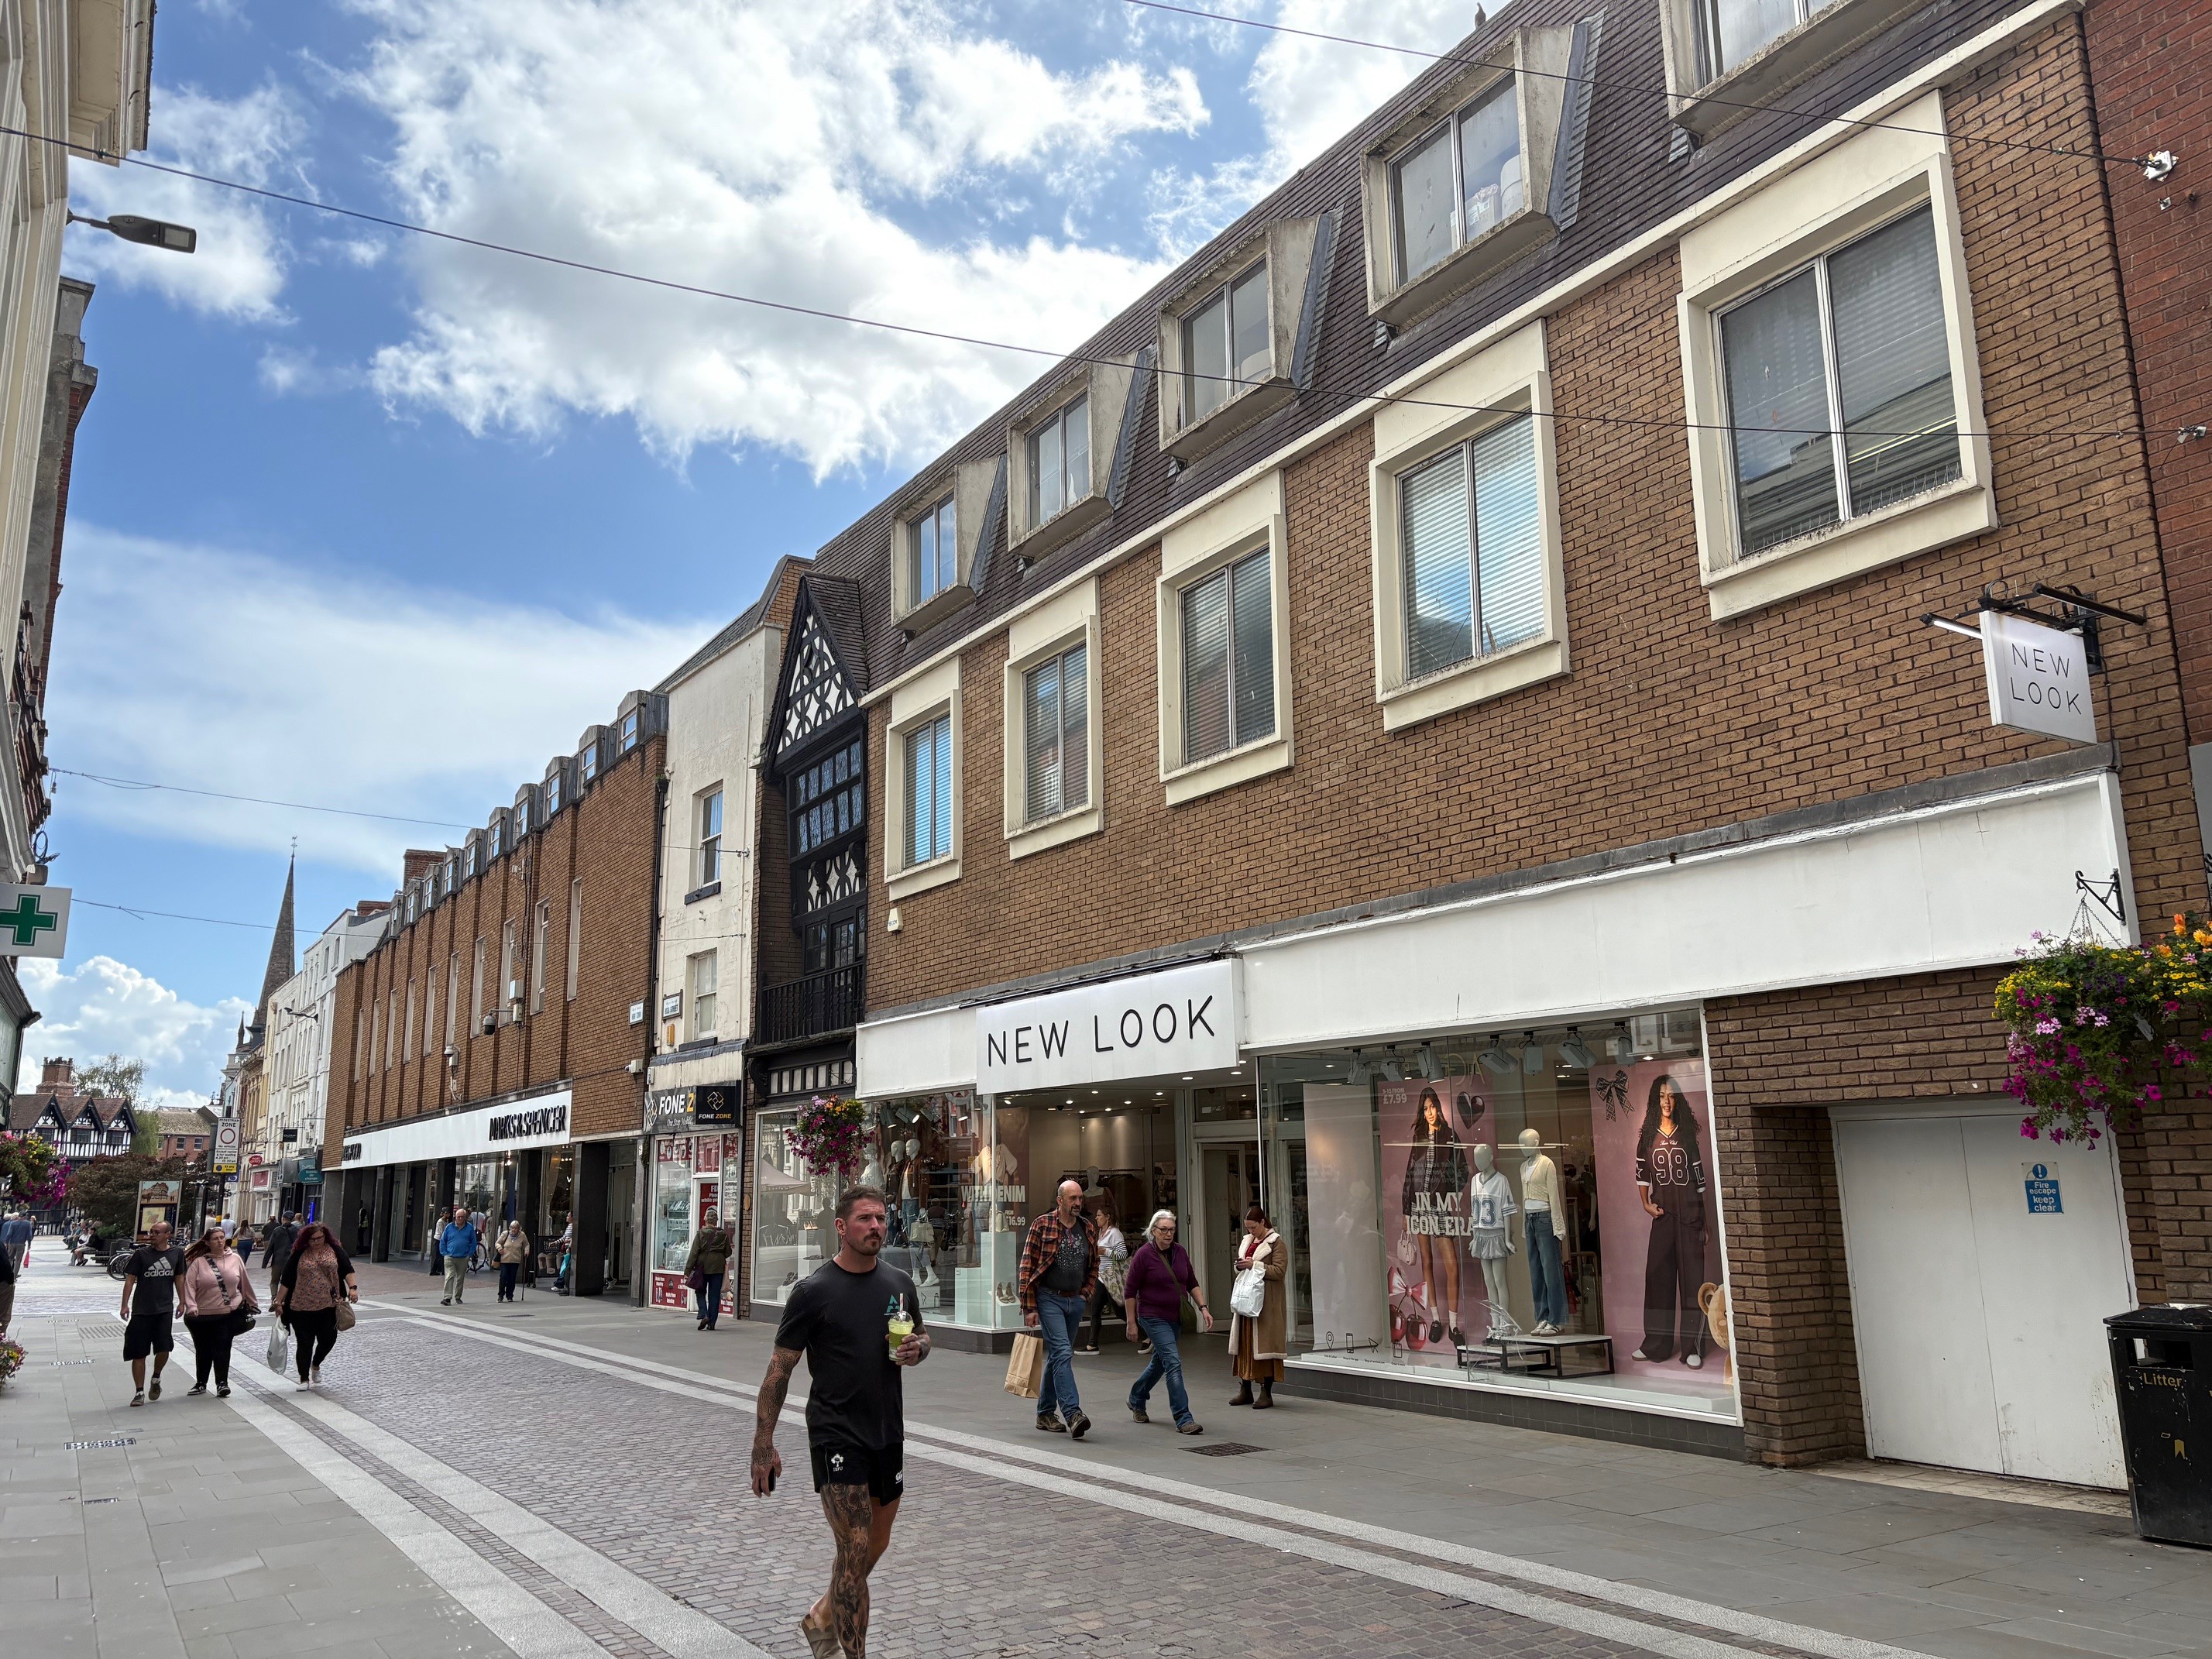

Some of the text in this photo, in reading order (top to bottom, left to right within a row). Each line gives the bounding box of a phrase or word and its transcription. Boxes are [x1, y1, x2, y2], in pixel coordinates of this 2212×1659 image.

[2012, 643, 2069, 678] NEW
[2011, 677, 2081, 715] LOOK
[988, 995, 1214, 1067] NEW LOOK
[659, 1094, 686, 1115] FONE
[1383, 1094, 1407, 1104] £7.99
[1652, 1147, 1689, 1186] 98
[961, 1186, 987, 1202] WITH
[1415, 1192, 1463, 1211] IN MY
[2033, 1196, 2054, 1204] keep
[1405, 1215, 1473, 1236] ICON ERA
[144, 1269, 174, 1278] adidas
[2143, 1373, 2182, 1387] Litter
